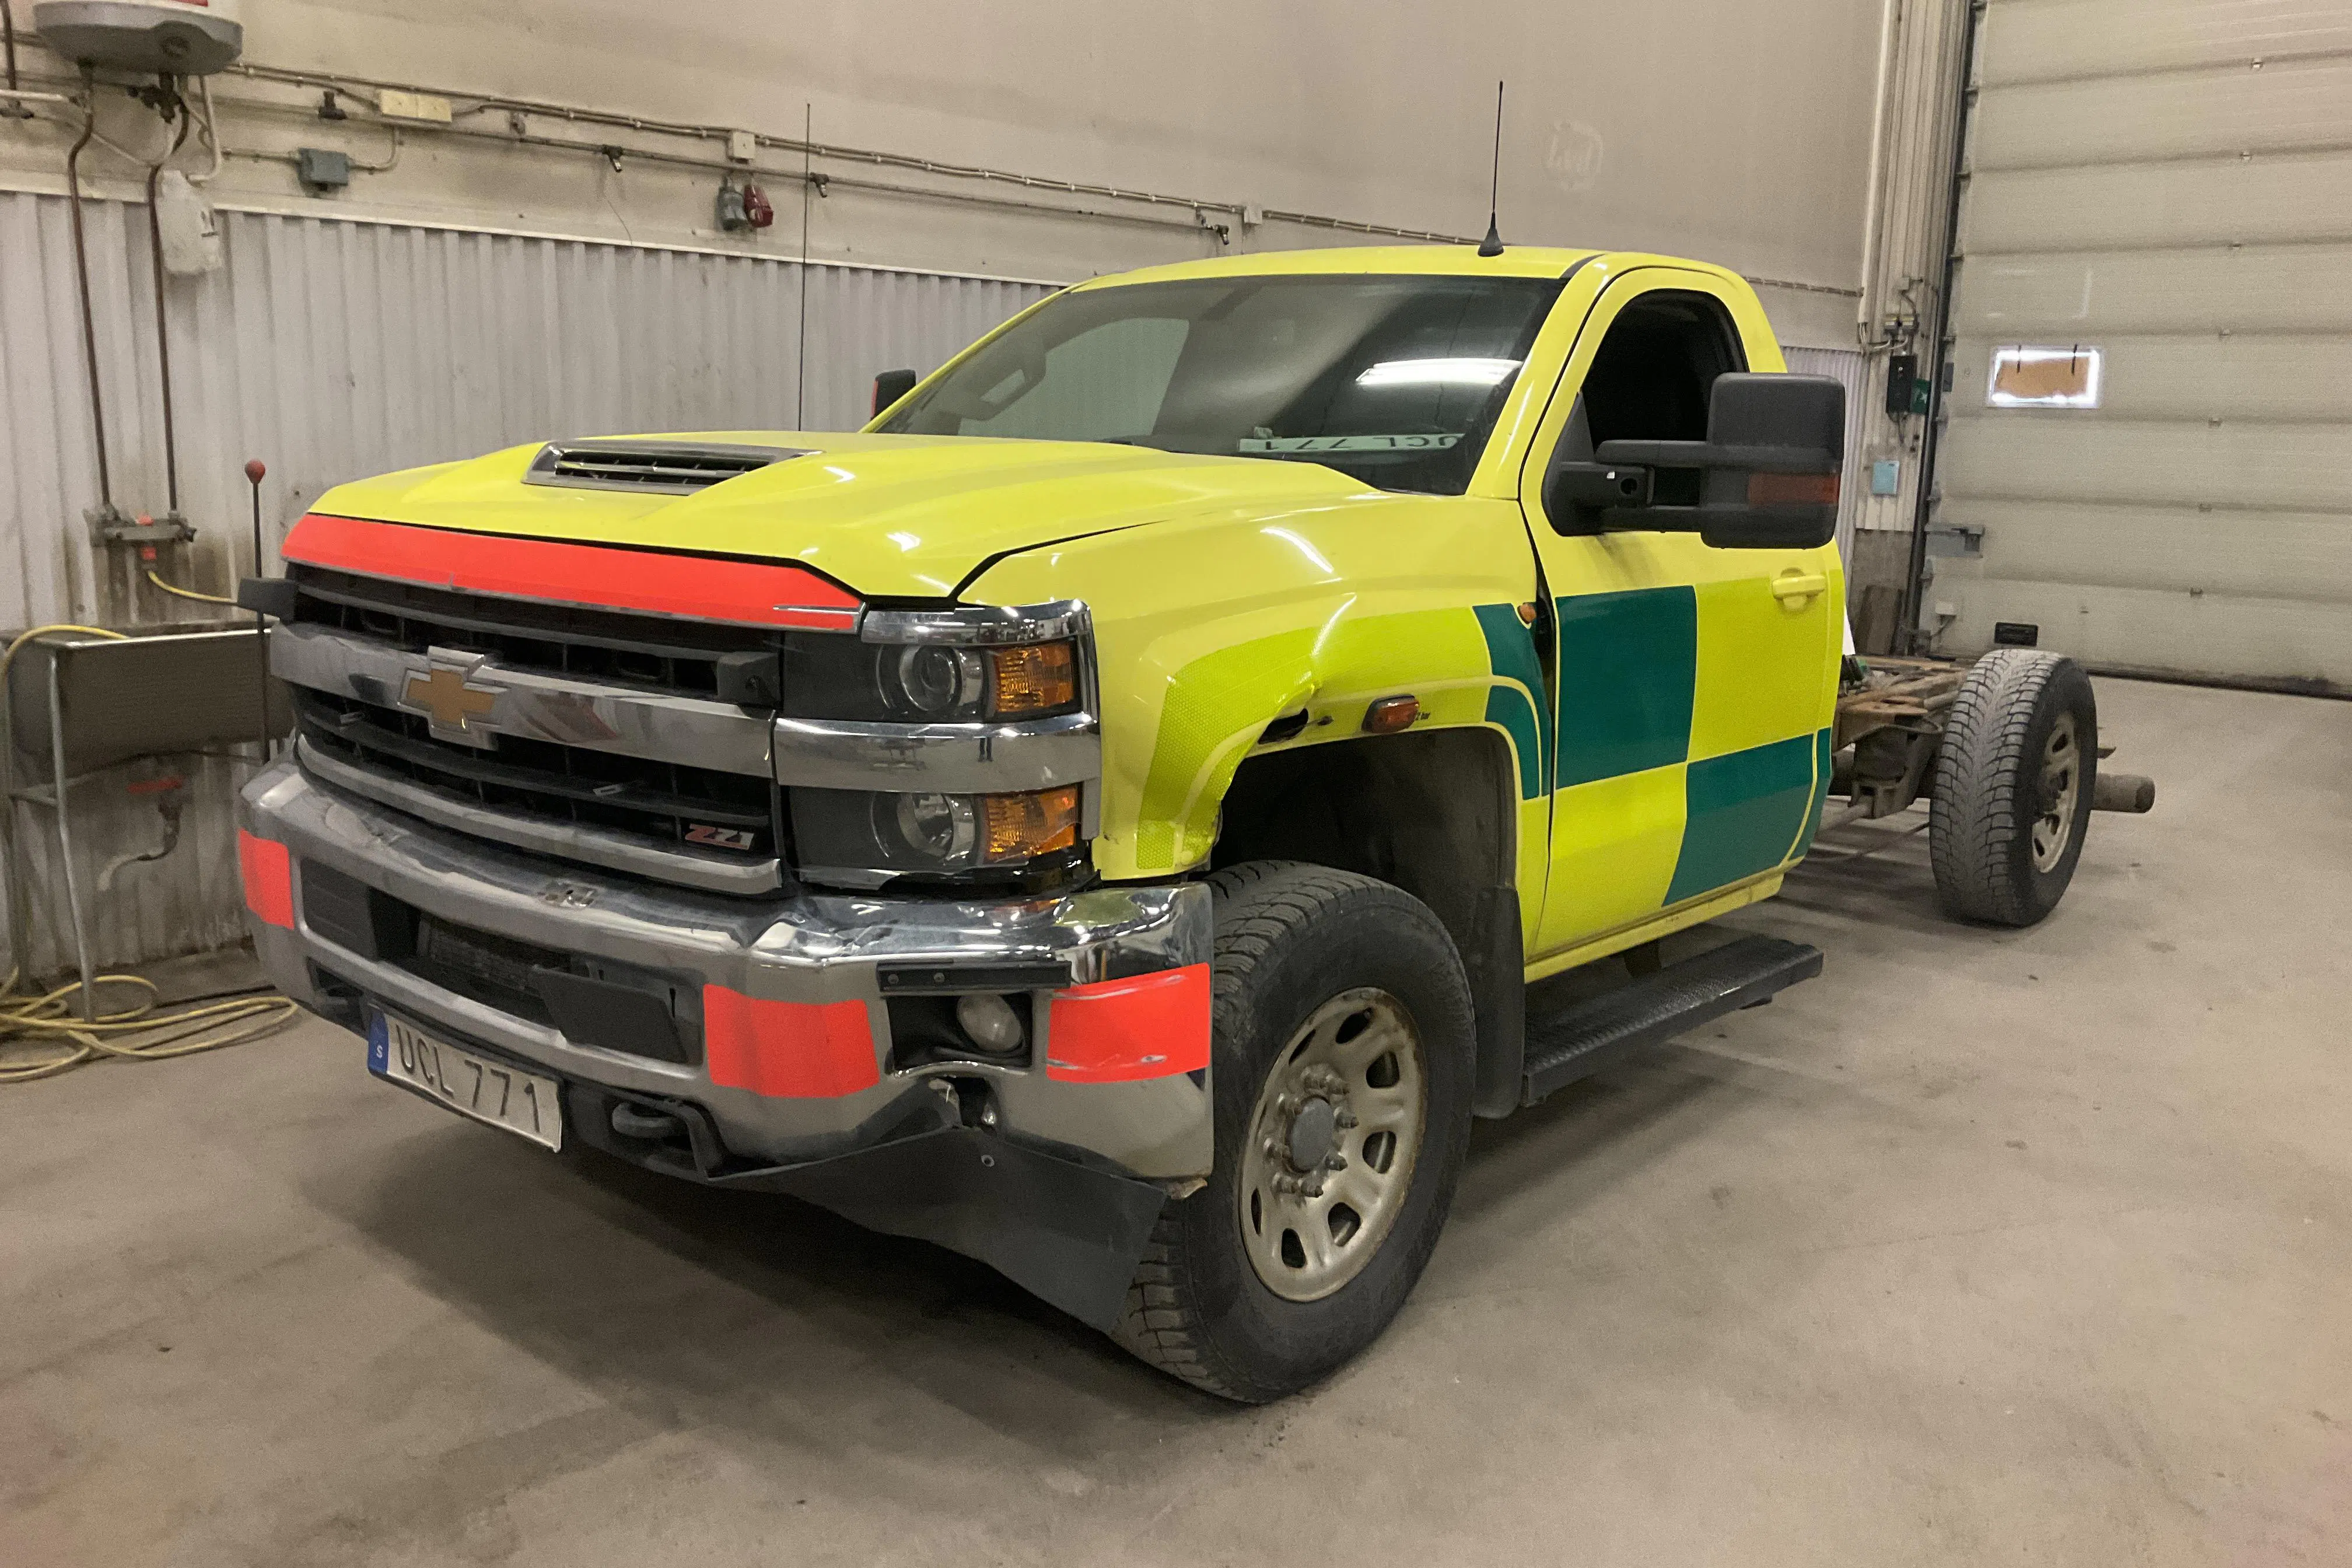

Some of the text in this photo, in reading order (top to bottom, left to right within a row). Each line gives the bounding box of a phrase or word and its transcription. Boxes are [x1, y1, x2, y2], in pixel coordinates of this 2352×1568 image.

[1265, 438, 1352, 450] 771
[685, 823, 754, 850] Z71
[376, 1045, 383, 1059] S
[396, 1024, 541, 1133] UCL 771
